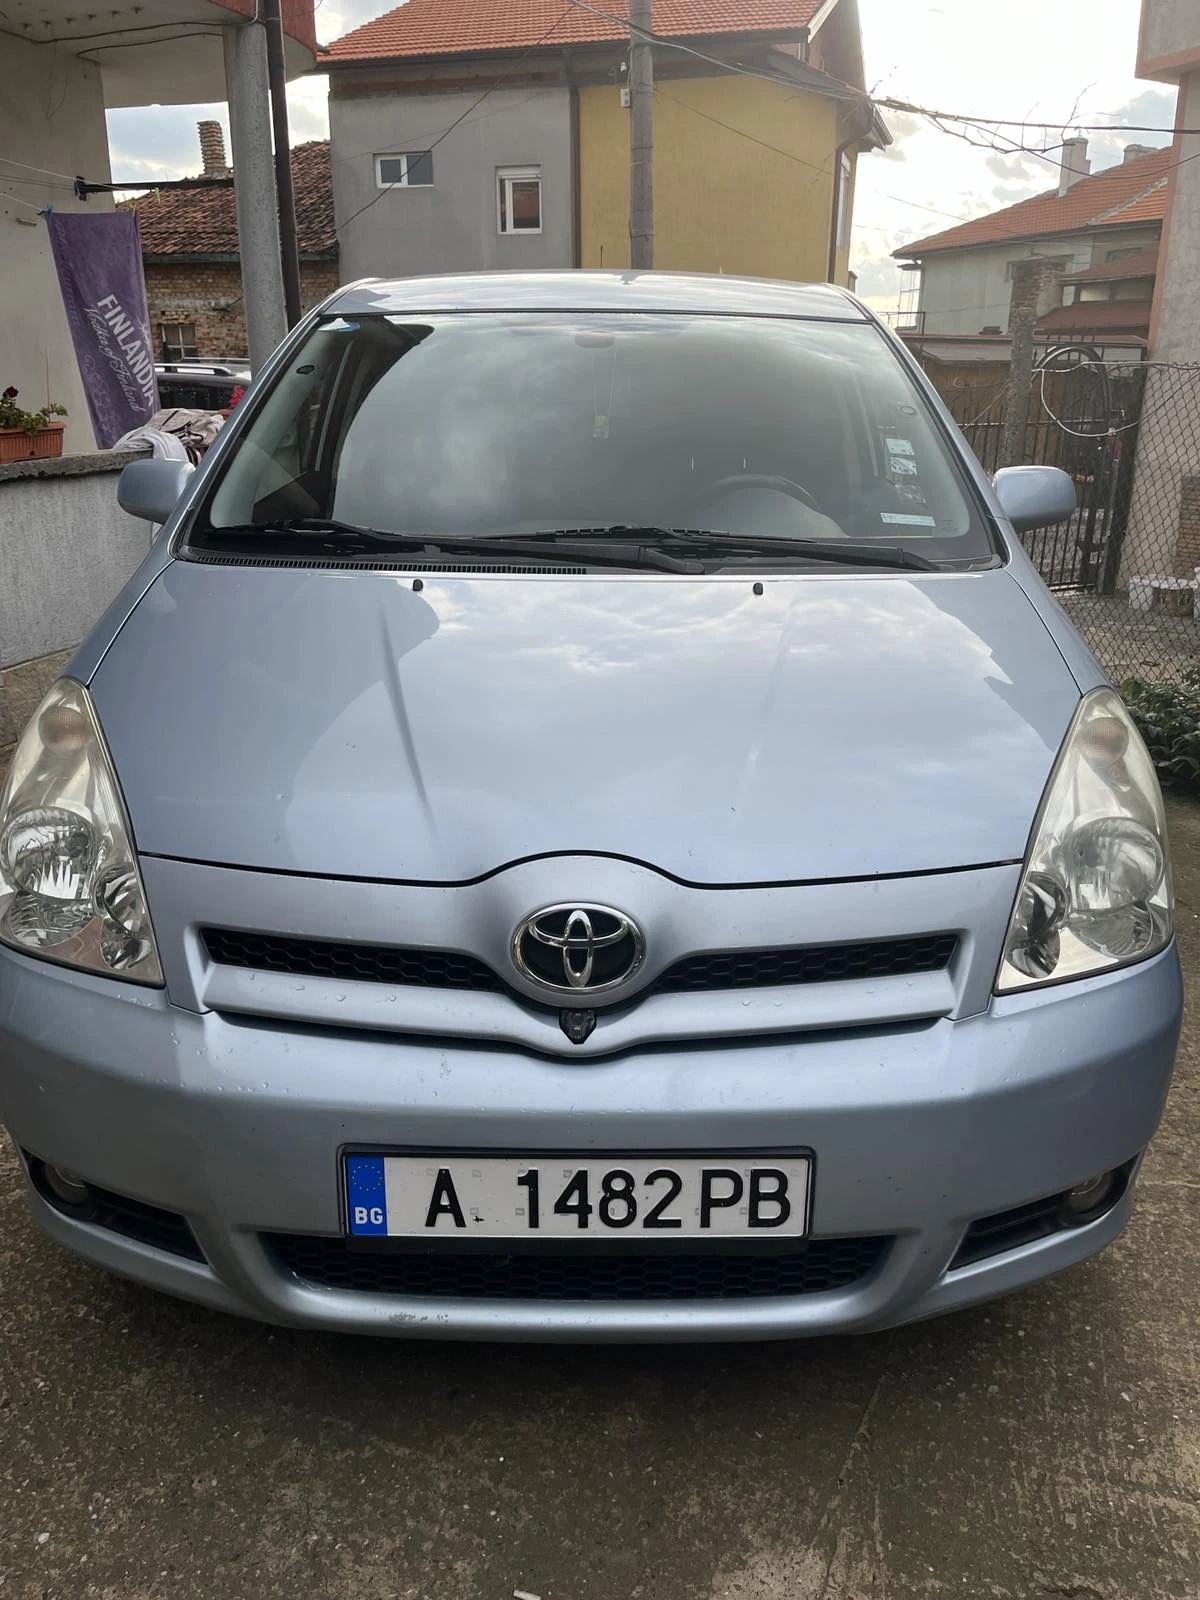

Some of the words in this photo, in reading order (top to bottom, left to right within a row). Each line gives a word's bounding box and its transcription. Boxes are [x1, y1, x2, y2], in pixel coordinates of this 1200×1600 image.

[84, 304, 111, 347] Vodka
[97, 294, 154, 406] FINLANDIA
[98, 345, 123, 366] of
[110, 361, 147, 412] Finland
[354, 1206, 384, 1225] BG
[425, 1168, 467, 1228] A
